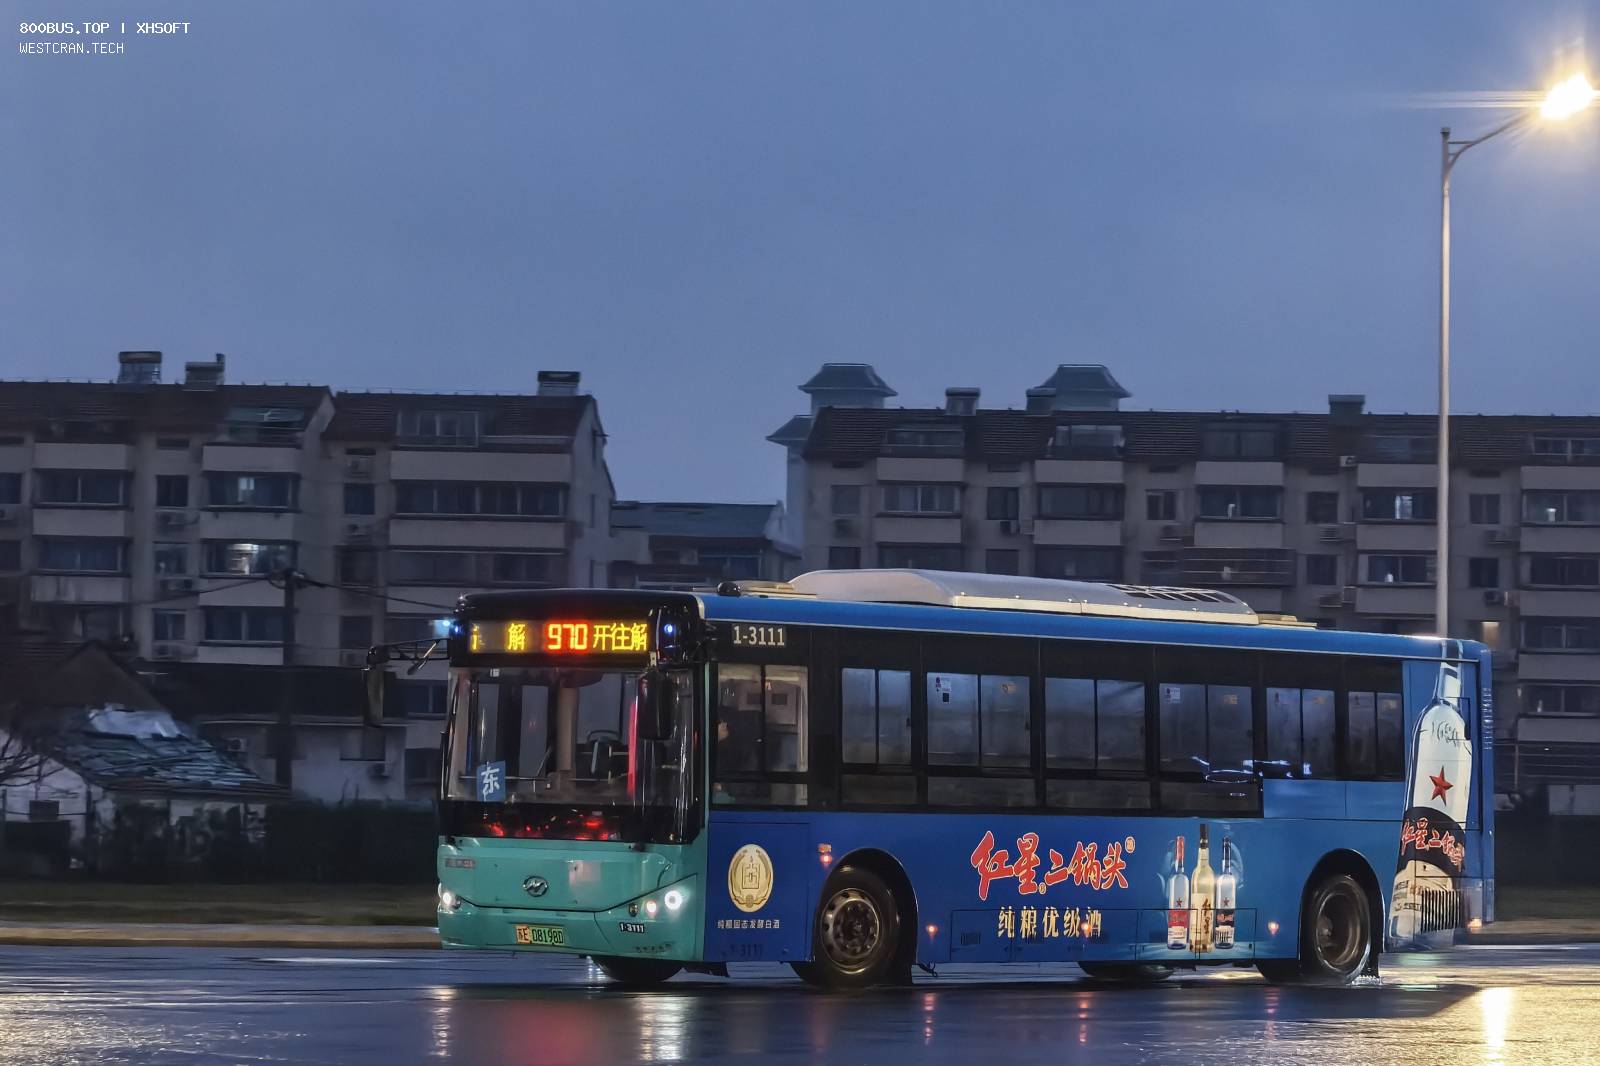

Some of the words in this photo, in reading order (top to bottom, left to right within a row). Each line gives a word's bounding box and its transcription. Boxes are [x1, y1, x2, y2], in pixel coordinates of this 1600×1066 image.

[547, 623, 588, 650] 970
[732, 624, 786, 646] 1-3111
[480, 765, 500, 794] 东
[970, 830, 1129, 901] 红星二锅头
[997, 905, 1103, 939] 纯粮优级酒
